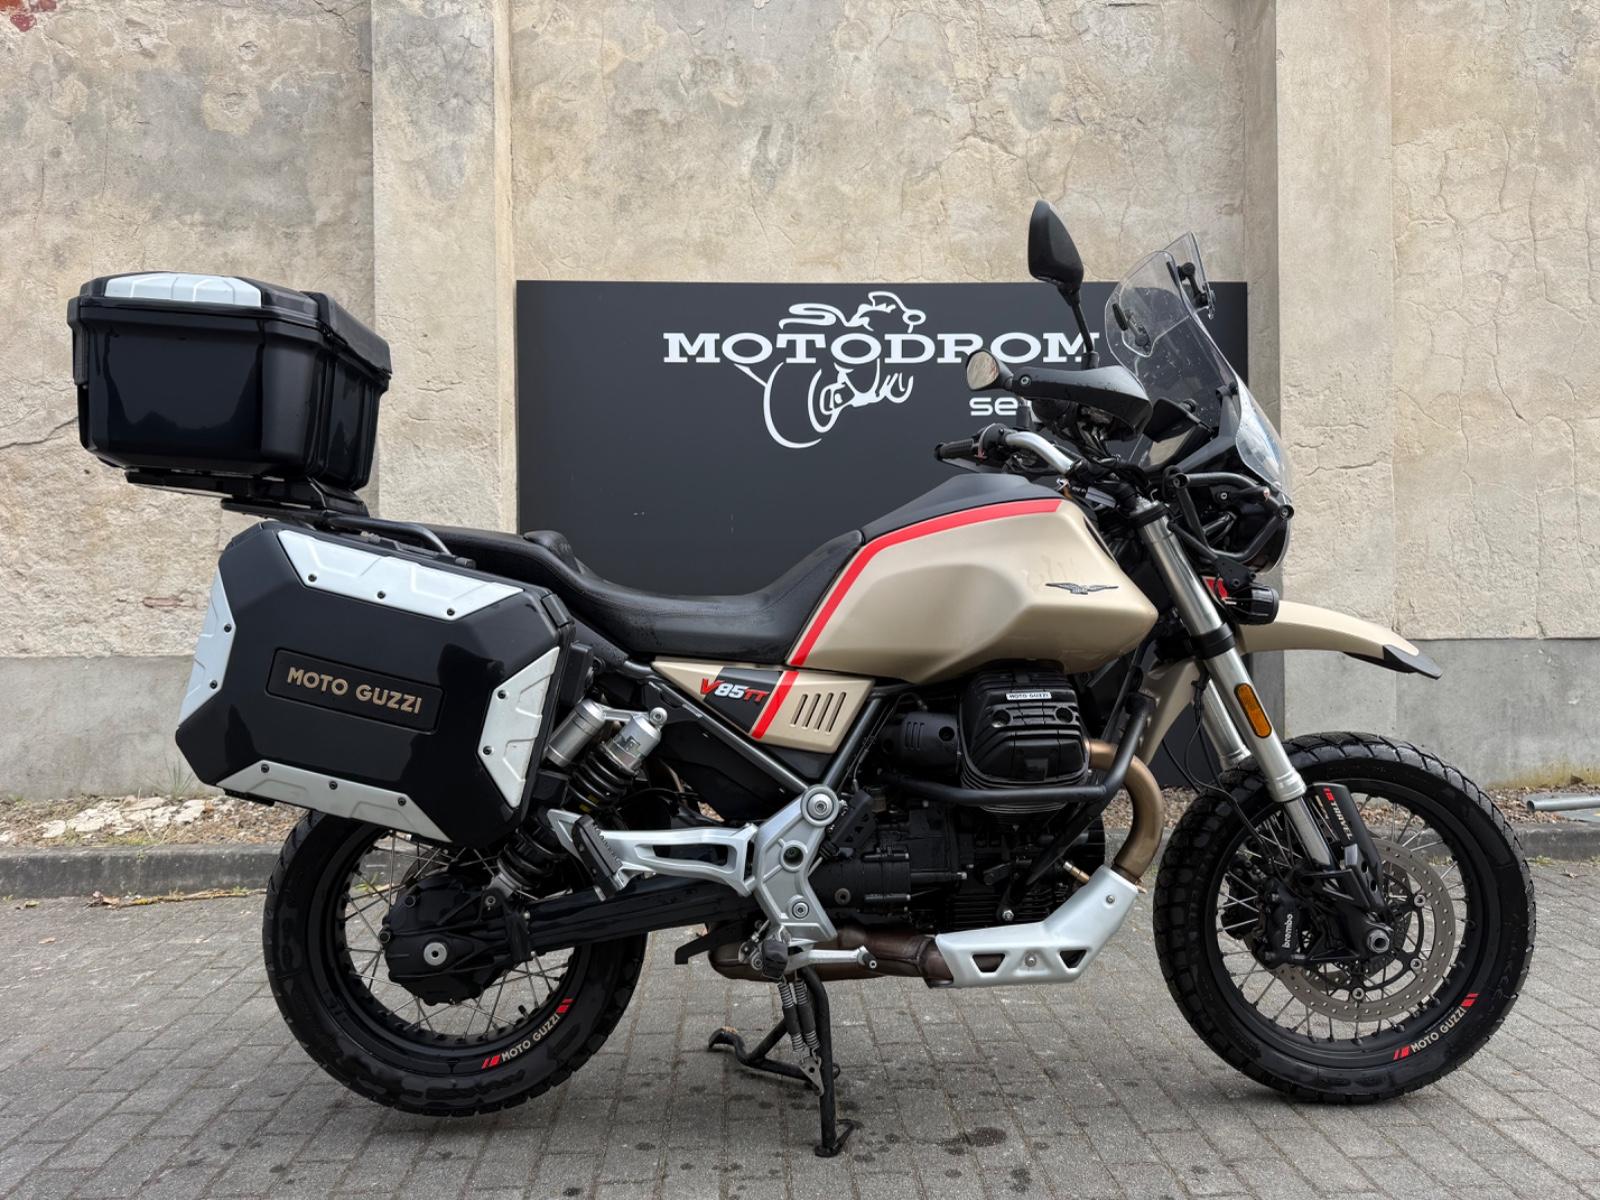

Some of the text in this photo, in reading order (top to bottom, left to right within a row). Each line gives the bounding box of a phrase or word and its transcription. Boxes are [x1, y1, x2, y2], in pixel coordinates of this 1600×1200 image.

[663, 332, 1100, 365] MOTODROM
[969, 397, 1018, 416] se
[287, 667, 423, 714] MOTO GUZZI
[1281, 913, 1294, 949] brembo
[501, 1013, 561, 1062] MOTO GUZZI
[1410, 1006, 1467, 1053] MOTO GUZZI
